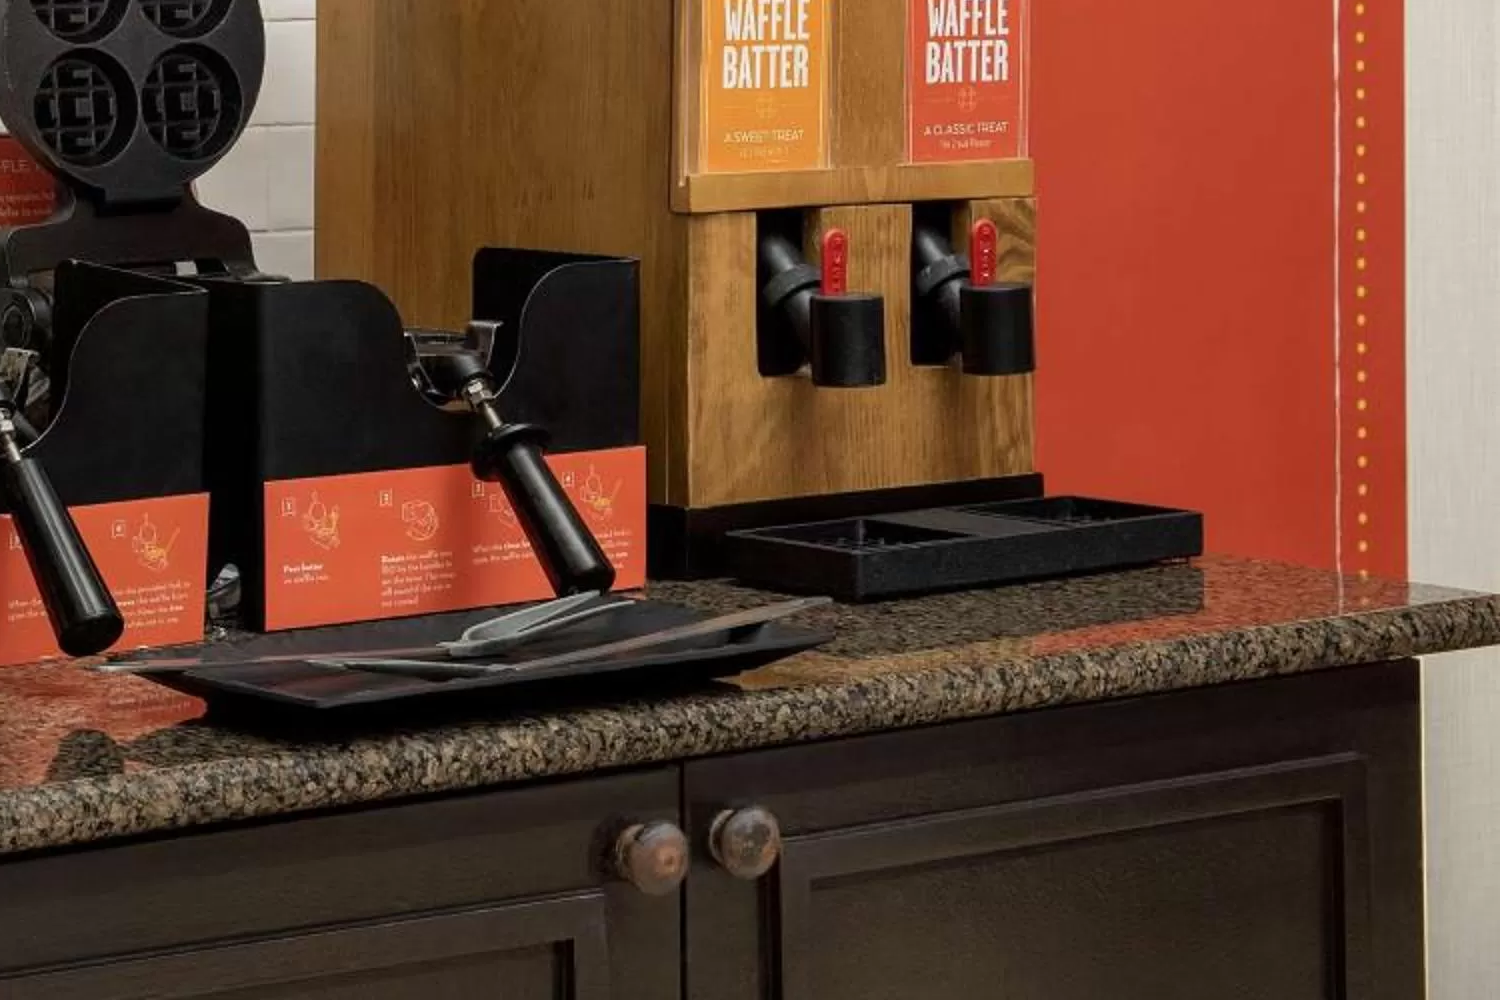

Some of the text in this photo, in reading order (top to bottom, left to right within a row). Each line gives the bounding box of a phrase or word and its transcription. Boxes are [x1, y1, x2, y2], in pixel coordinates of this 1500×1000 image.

[722, 44, 809, 89] BATTER
[925, 39, 1009, 84] BATTER
[772, 128, 805, 142] TREAT
[933, 123, 975, 136] CLASSIC
[977, 121, 1010, 134] TREAT
